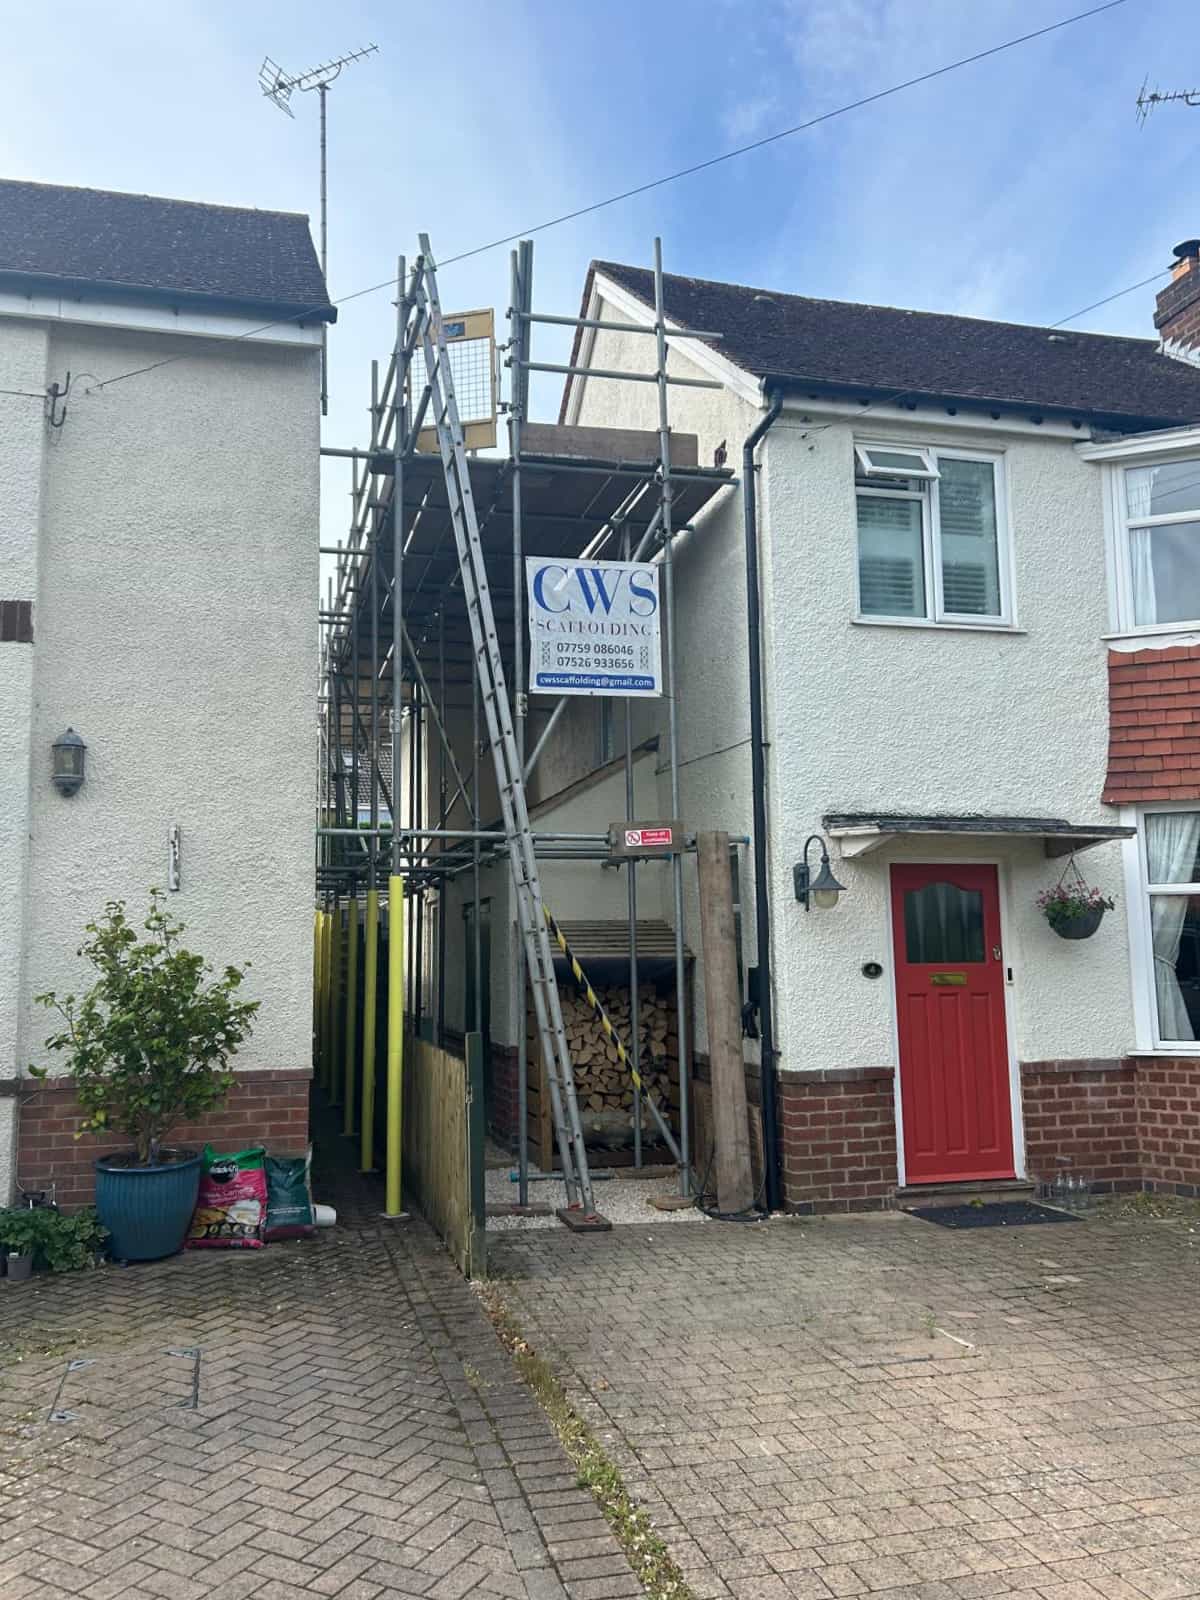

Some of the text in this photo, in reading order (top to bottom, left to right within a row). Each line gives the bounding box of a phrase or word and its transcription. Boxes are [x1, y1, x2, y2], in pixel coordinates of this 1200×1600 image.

[533, 565, 657, 617] CWS
[536, 620, 652, 636] SCAFFOLDING
[556, 642, 634, 656] 07759 086046
[556, 656, 635, 669] 07526 933656
[539, 675, 653, 687] cwsscaffolding@gmail.com
